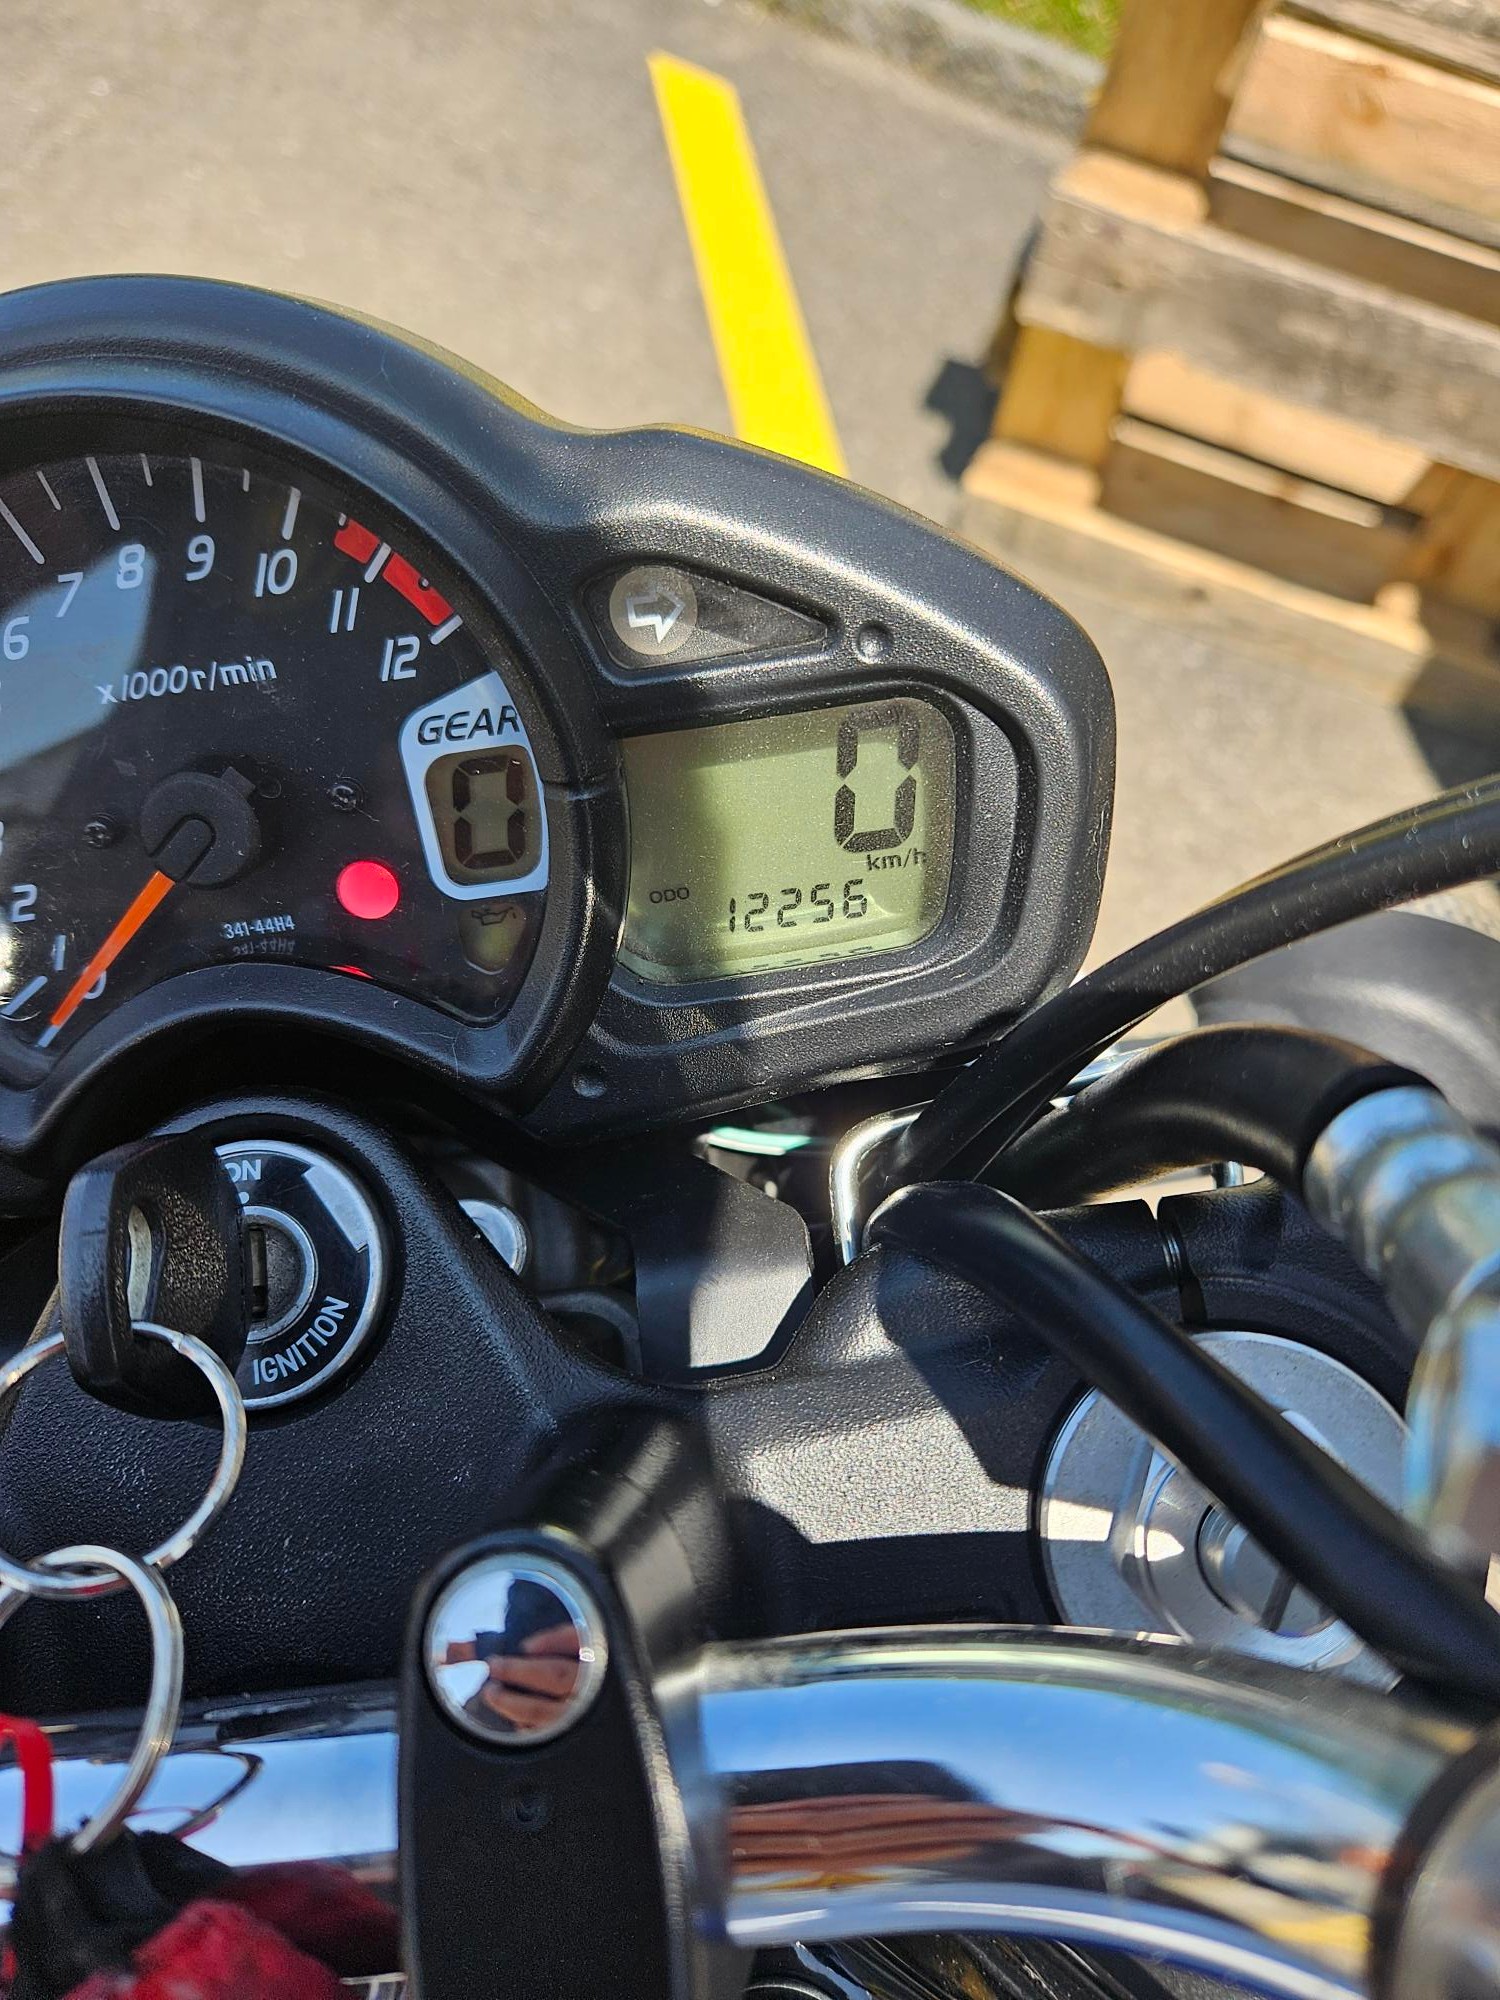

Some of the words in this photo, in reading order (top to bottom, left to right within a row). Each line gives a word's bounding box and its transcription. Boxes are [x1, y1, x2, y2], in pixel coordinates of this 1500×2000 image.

[117, 544, 145, 589] 8
[186, 535, 215, 581] 9
[255, 549, 298, 597] 10
[56, 572, 83, 618] 7
[330, 587, 360, 633] 11
[4, 616, 29, 660] 6
[381, 636, 420, 681] 12
[417, 705, 520, 746] GEAR
[836, 705, 921, 853] 0
[866, 848, 928, 872] km/h
[11, 884, 37, 922] 2
[649, 887, 690, 904] ODO
[728, 878, 868, 933] 12256
[223, 914, 295, 939] 341-44H4
[54, 935, 66, 970] 1
[253, 1295, 349, 1385] IGNITION
